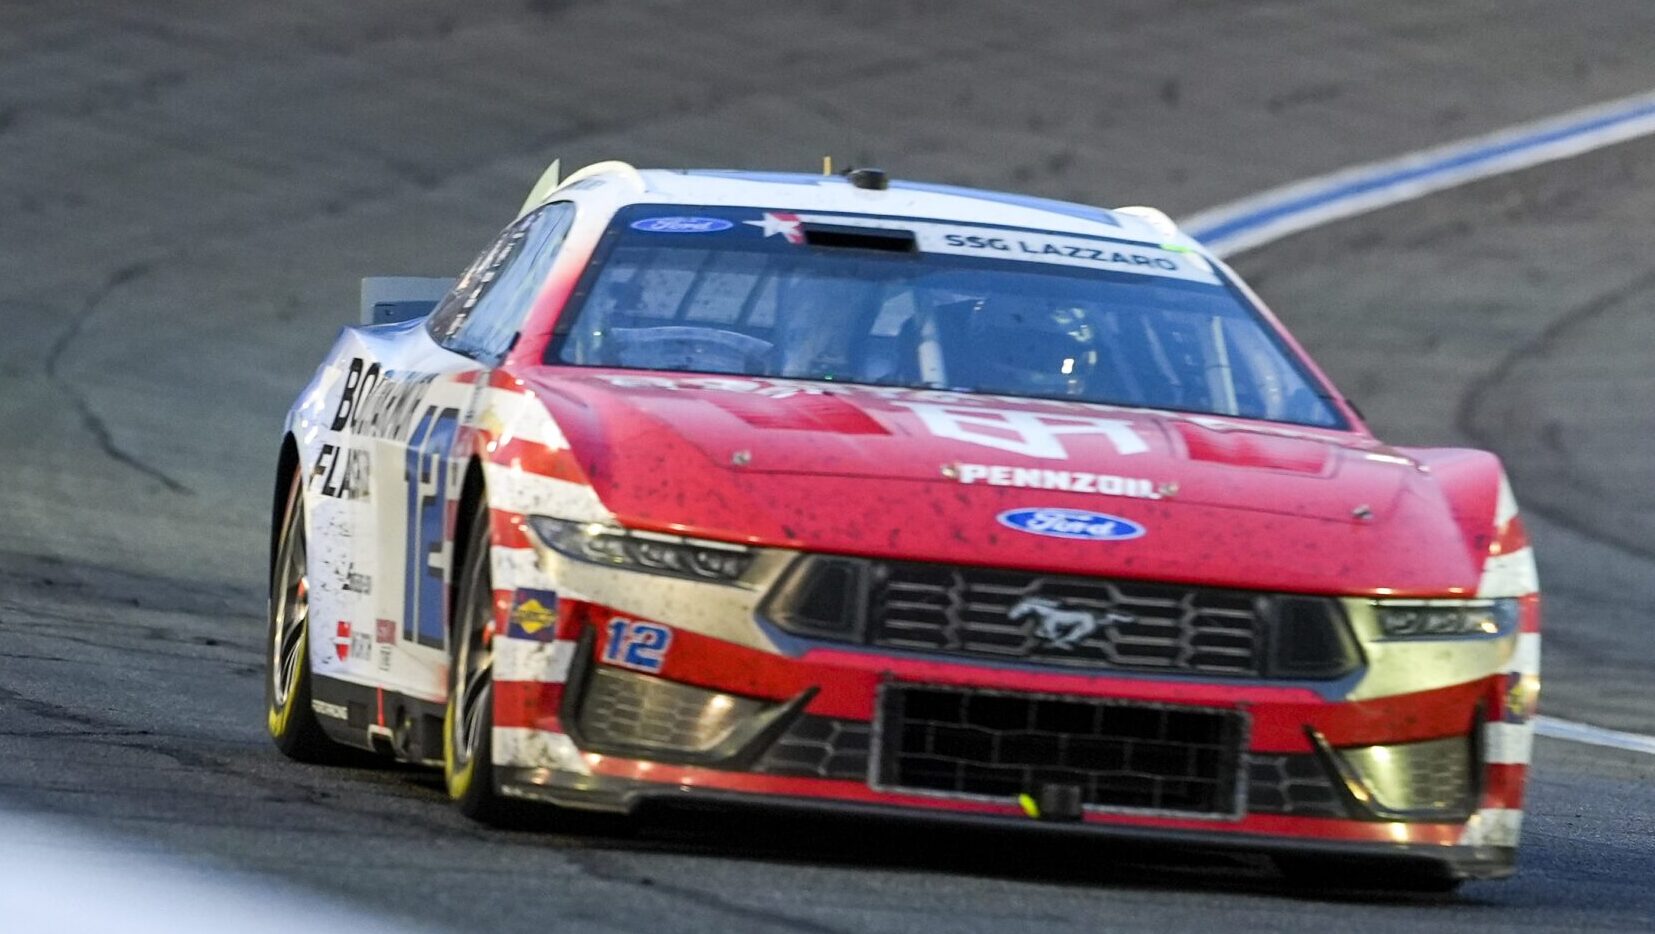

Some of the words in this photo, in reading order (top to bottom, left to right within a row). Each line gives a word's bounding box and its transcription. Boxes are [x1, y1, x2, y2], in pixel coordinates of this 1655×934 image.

[945, 233, 1010, 251] SSG
[1017, 240, 1179, 272] LAZZARO
[957, 463, 1164, 500] PENNZOIL
[605, 618, 672, 673] 12
